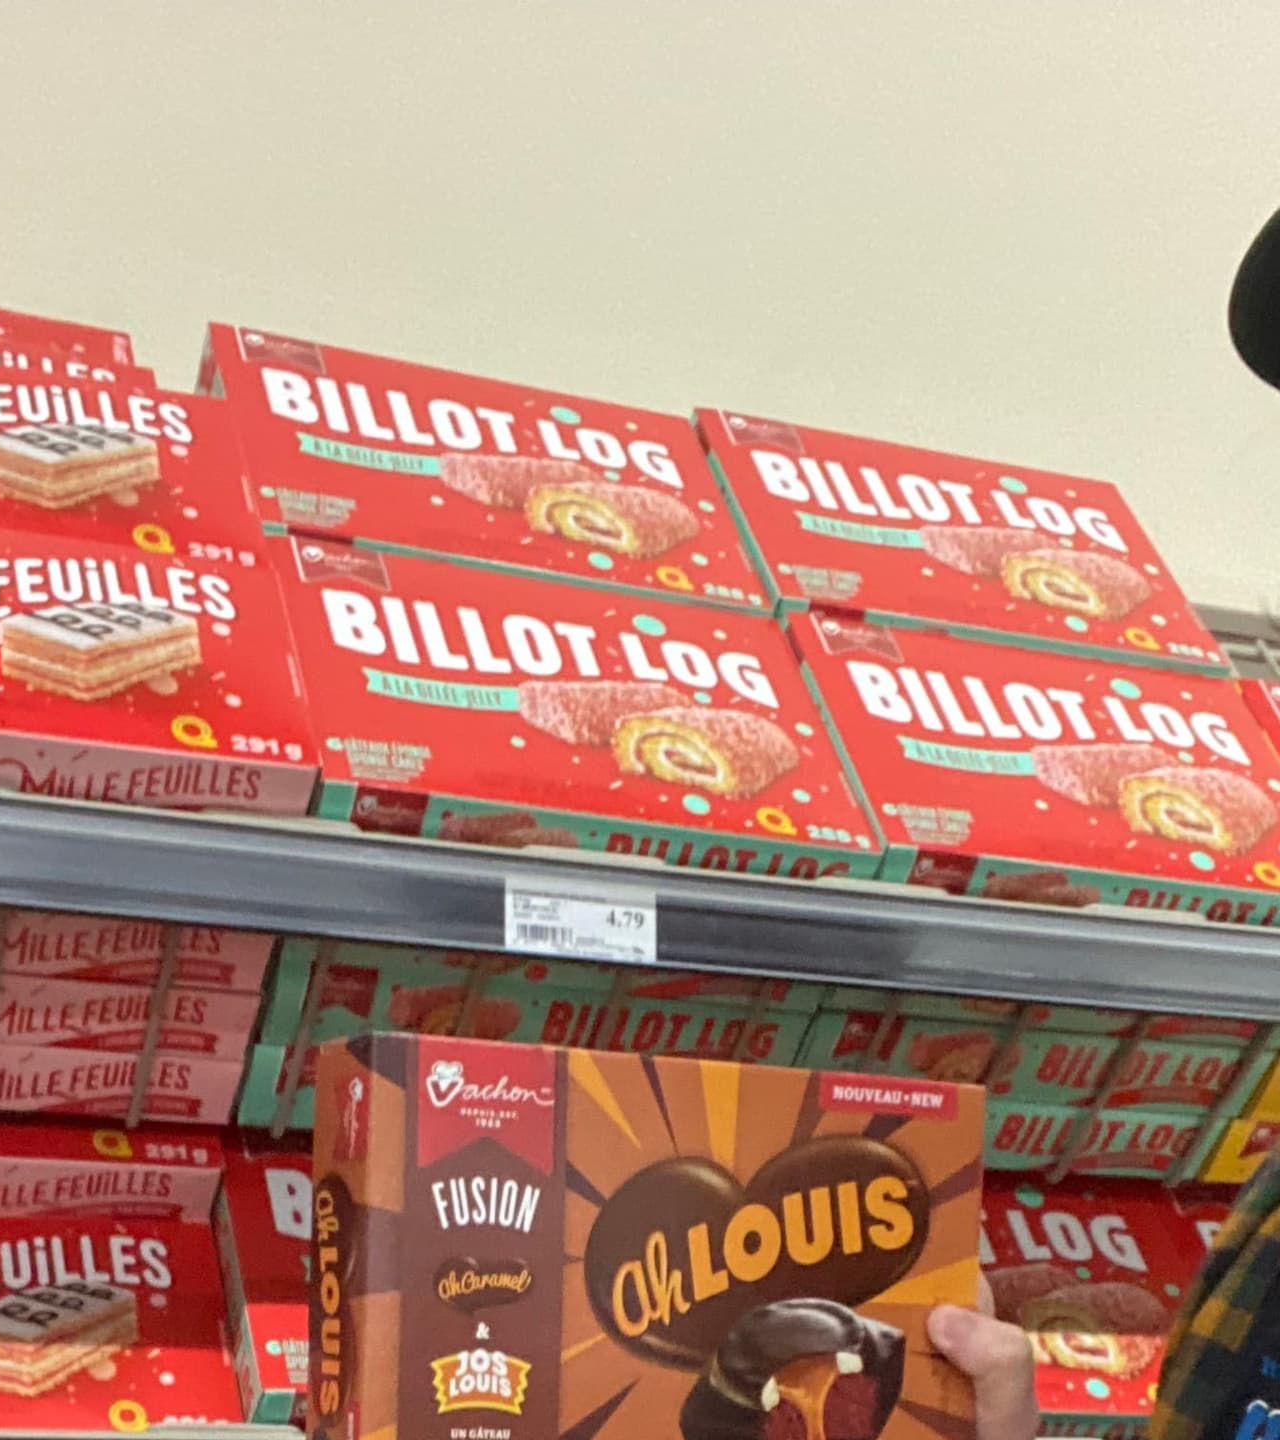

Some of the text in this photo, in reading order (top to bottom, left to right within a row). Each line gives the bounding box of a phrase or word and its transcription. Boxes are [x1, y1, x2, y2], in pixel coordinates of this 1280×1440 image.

[260, 367, 684, 489] BILLOT LOG
[750, 449, 983, 525] BILLOT
[989, 489, 1129, 553] LOG
[321, 587, 780, 709] BILLOT LOG
[845, 660, 1252, 766] BILLOT LOG
[231, 734, 280, 756] 291
[605, 908, 645, 929] 4.79
[425, 1059, 555, 1108] Vachon
[431, 1175, 541, 1234] FUSION
[687, 1174, 915, 1302] LOUIS
[1006, 1208, 1149, 1272] LOG
[319, 1251, 341, 1415] LOUIS
[475, 1321, 490, 1340] &
[449, 1374, 513, 1398] LOUIS
[456, 1347, 509, 1377] JOS
[450, 1427, 511, 1440] UN GÂTEAU
